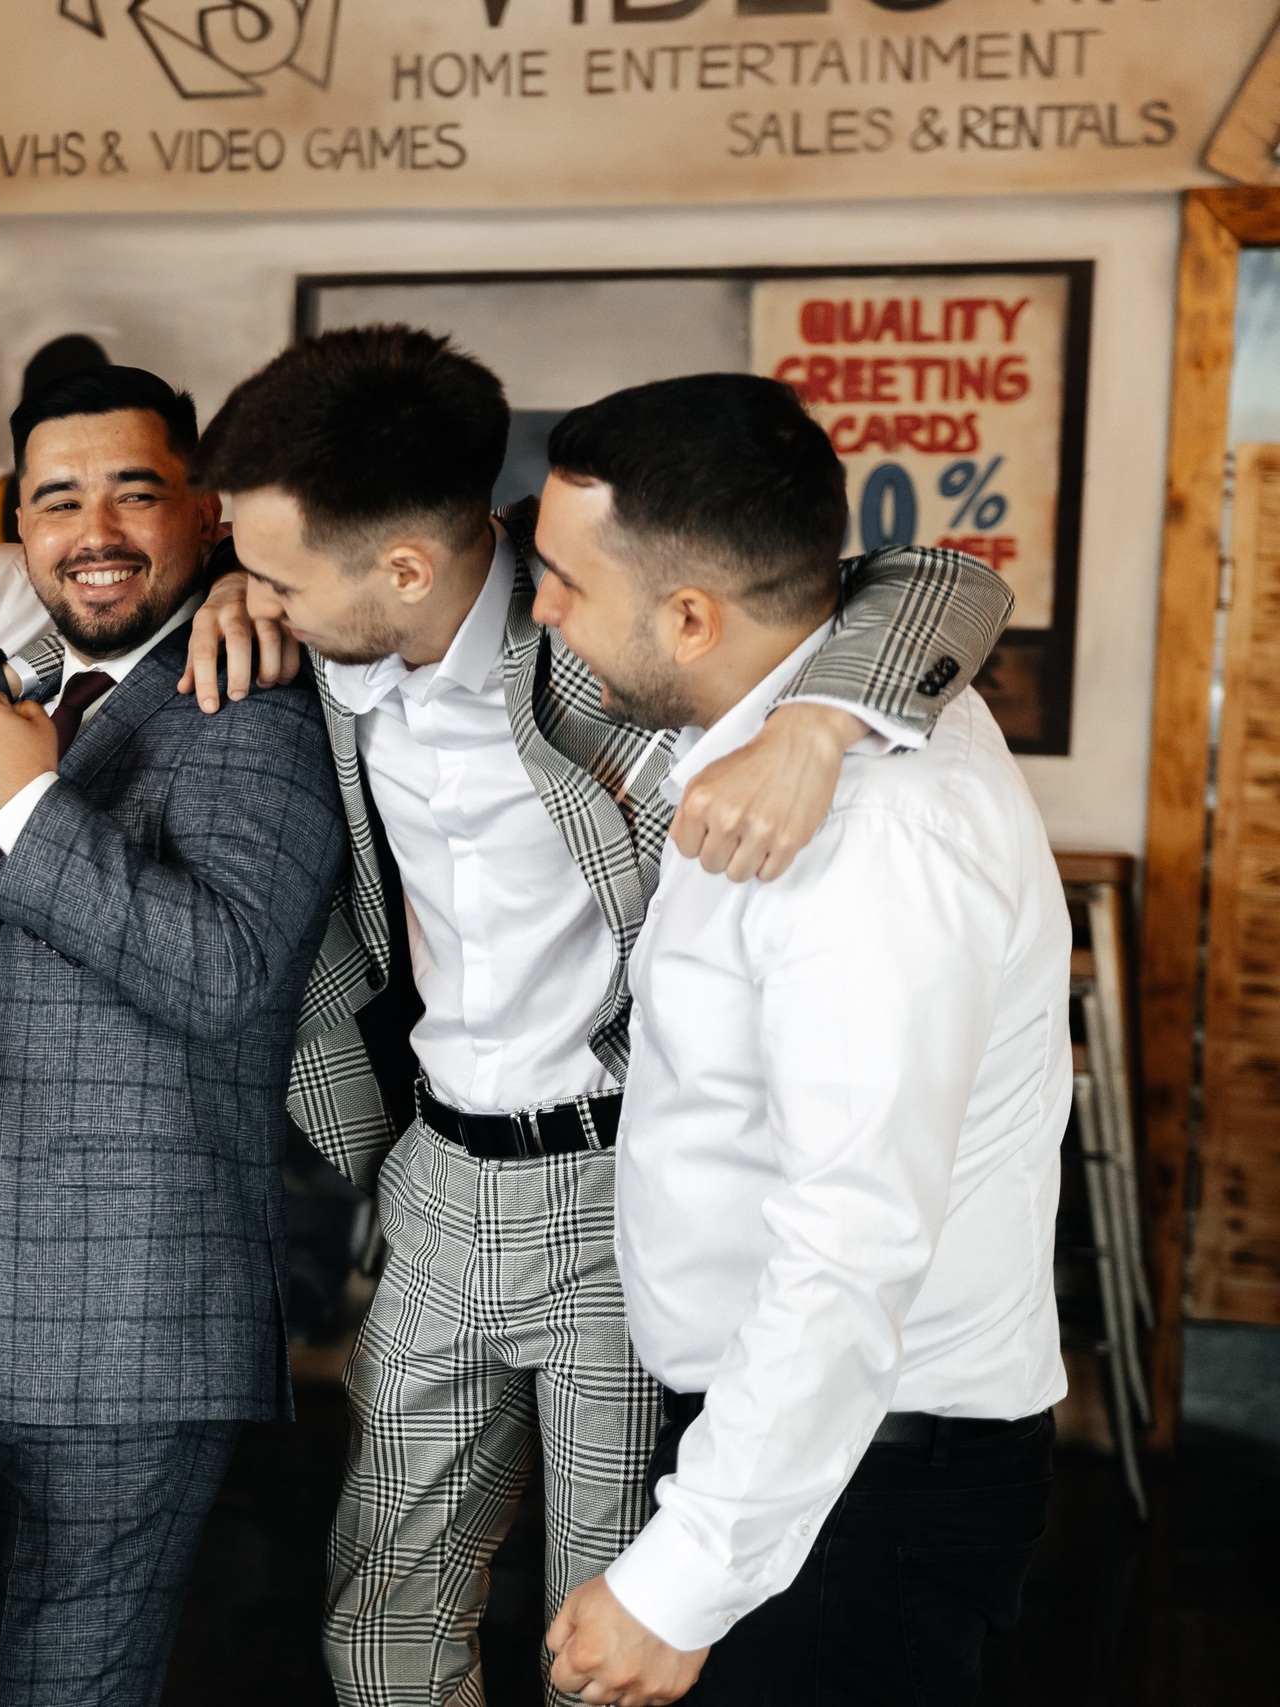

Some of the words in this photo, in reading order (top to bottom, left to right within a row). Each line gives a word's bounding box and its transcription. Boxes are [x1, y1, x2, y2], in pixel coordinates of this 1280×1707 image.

[391, 50, 548, 100] HOME
[585, 28, 1101, 95] ENTERTAINMENT
[98, 130, 128, 175] &
[149, 127, 286, 174] VIDEO
[303, 123, 468, 171] GAMES
[727, 106, 894, 157] SALES
[798, 298, 1031, 344] QUALITY
[772, 355, 1031, 405] GREETING
[830, 412, 981, 455] CARDS
